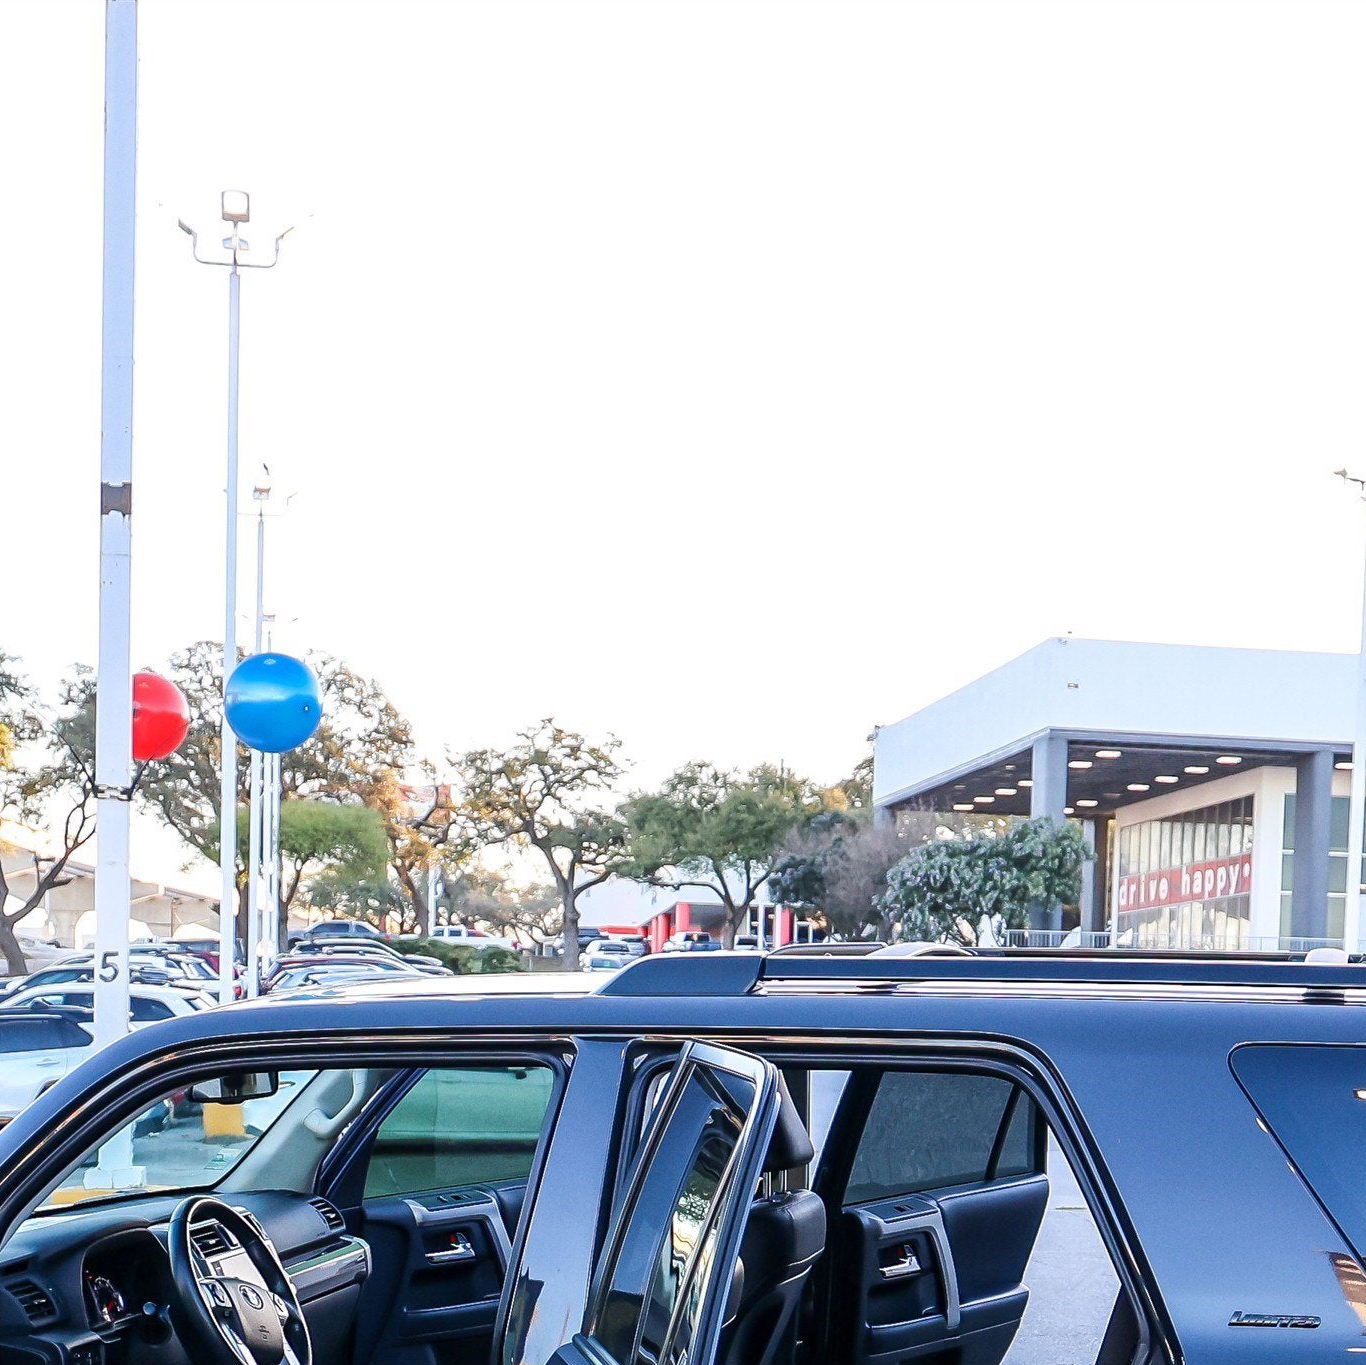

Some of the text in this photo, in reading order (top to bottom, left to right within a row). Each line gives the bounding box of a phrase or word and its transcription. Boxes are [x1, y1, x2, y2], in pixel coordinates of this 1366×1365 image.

[1119, 863, 1240, 906] drive happy
[98, 950, 119, 983] 5
